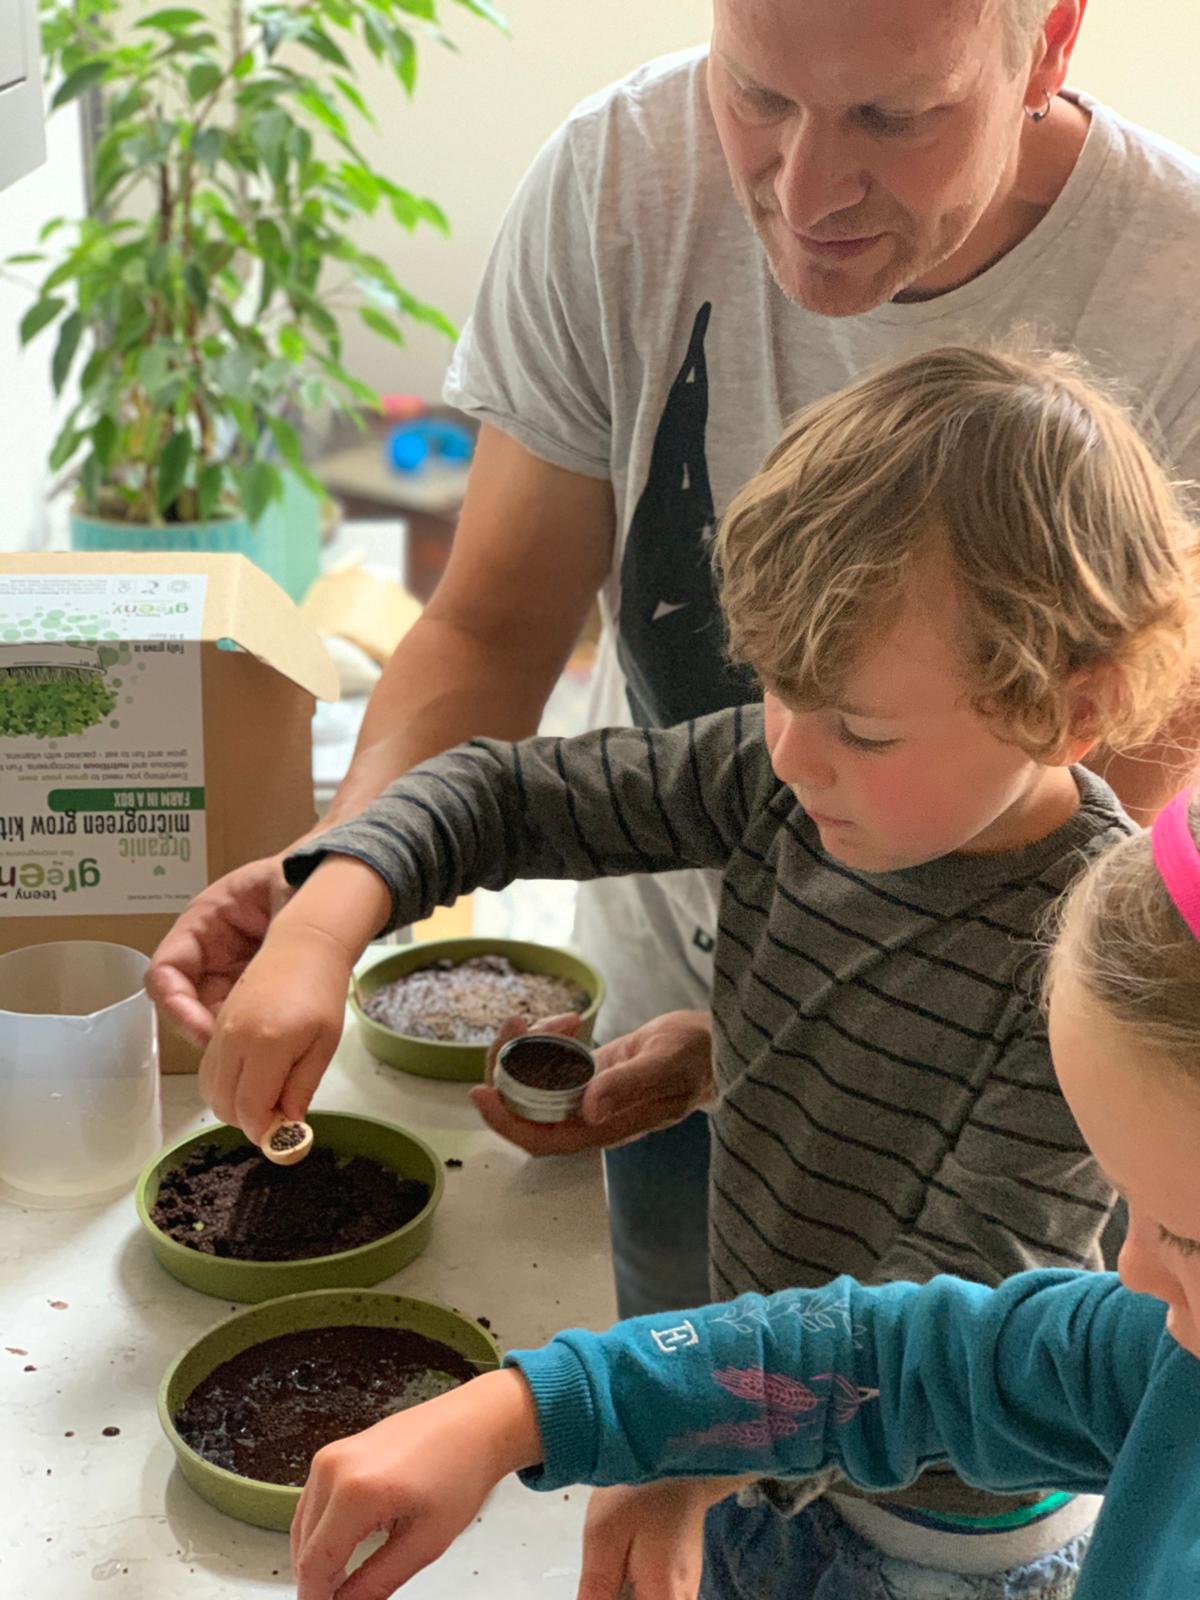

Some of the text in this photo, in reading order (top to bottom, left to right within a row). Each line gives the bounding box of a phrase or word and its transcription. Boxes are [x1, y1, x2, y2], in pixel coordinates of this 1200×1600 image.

[44, 752, 62, 760] with
[83, 762, 130, 770] nutritious
[132, 762, 148, 770] and
[126, 772, 140, 780] you
[144, 772, 188, 781] Everything
[112, 792, 190, 808] FARM IN A BOX
[0, 808, 190, 842] microgreen grow kit
[120, 833, 190, 862] Organic
[14, 888, 56, 901] teeny
